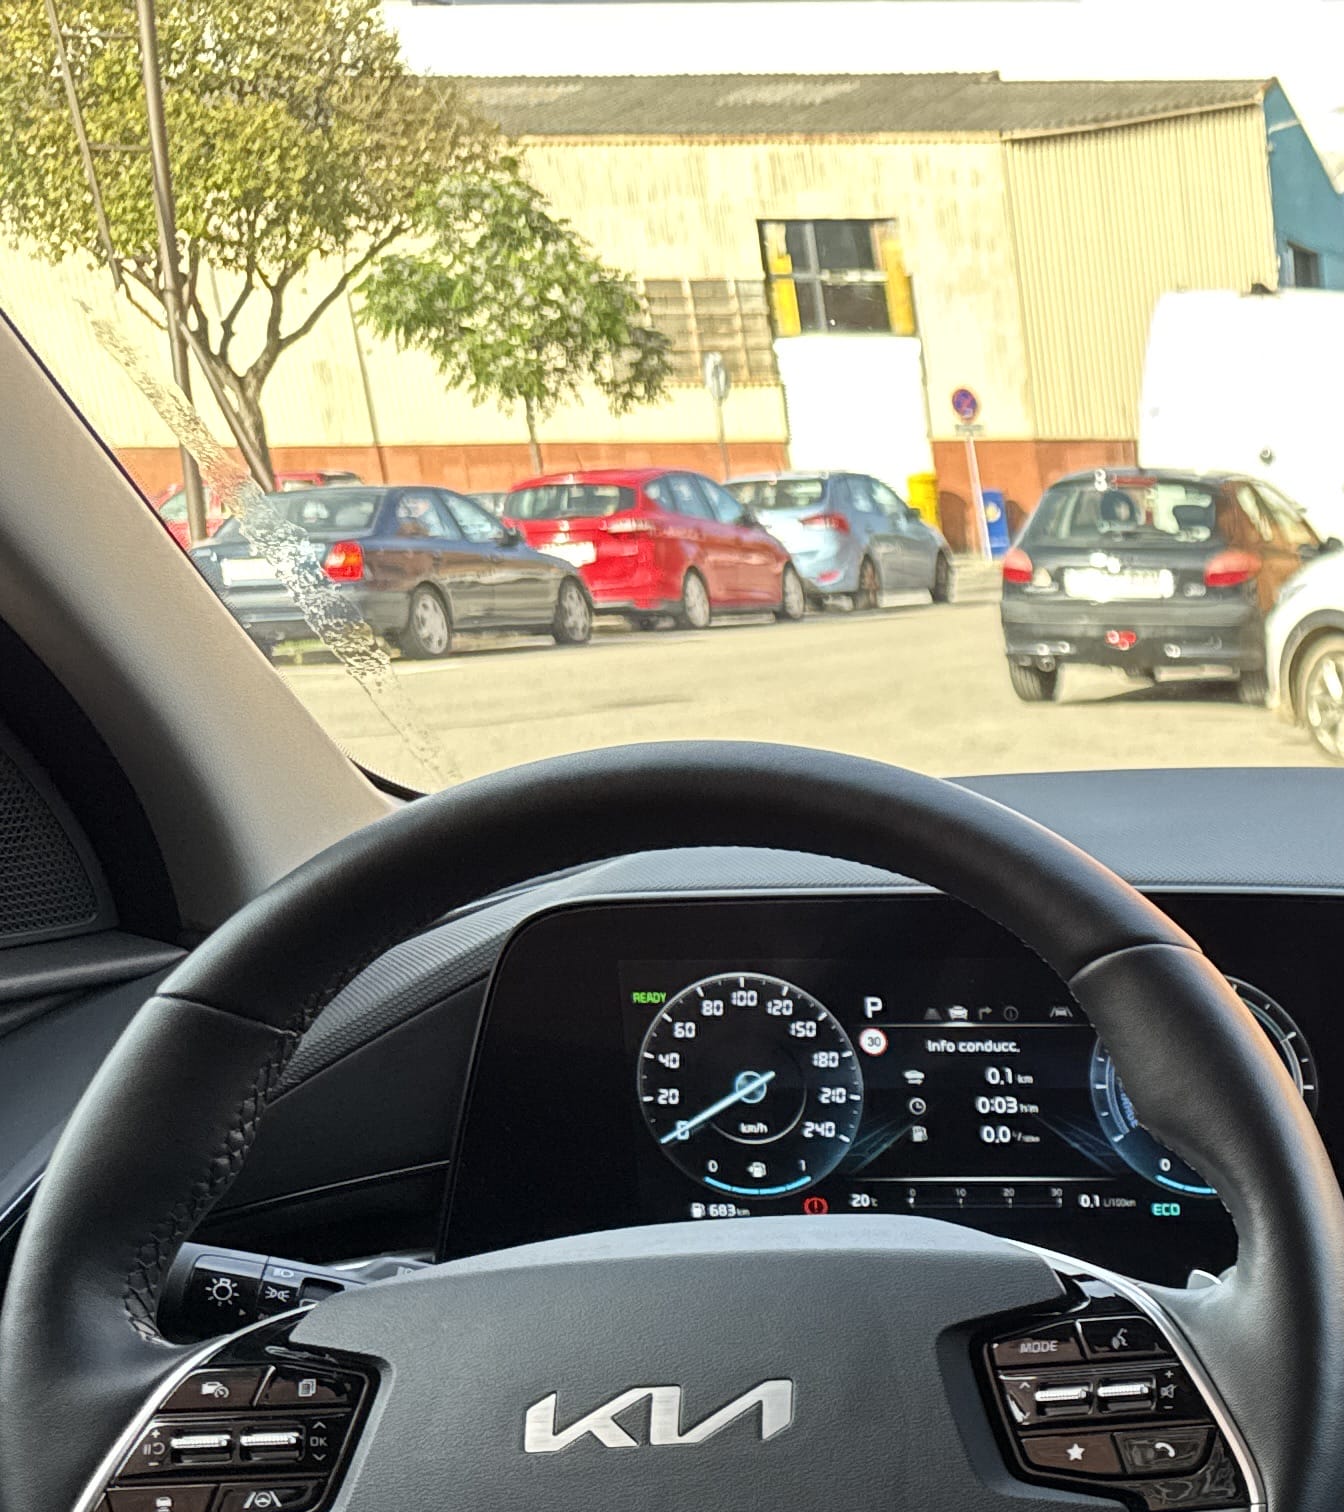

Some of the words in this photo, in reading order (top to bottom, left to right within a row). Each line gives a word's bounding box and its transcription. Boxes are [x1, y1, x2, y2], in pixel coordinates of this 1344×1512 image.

[632, 992, 667, 1004] READY
[731, 990, 758, 1007] 100
[701, 1000, 724, 1016] 80
[766, 1000, 793, 1016] 120
[864, 996, 883, 1018] P
[673, 1022, 696, 1038] 60
[789, 1021, 817, 1038] 150
[867, 1036, 882, 1047] 30
[927, 1040, 955, 1052] Info
[958, 1040, 1021, 1053] conducc.
[658, 1052, 680, 1069] 40
[812, 1051, 839, 1068] 180
[985, 1067, 1013, 1085] 0.1
[1017, 1074, 1034, 1085] km
[657, 1088, 680, 1105] 20
[819, 1087, 847, 1104] 210
[976, 1096, 1018, 1114] 0:03
[740, 1122, 768, 1134] km/h
[803, 1121, 836, 1138] 240
[981, 1126, 1012, 1143] 0.0
[707, 1160, 718, 1172] 0
[799, 1159, 806, 1172] 1
[1159, 1158, 1171, 1172] 0
[955, 1188, 967, 1197] 10
[1003, 1188, 1015, 1197] 20
[1051, 1188, 1063, 1197] 30
[1078, 1194, 1101, 1208] 0.1
[709, 1204, 737, 1217] 683
[1152, 1203, 1181, 1216] ECO
[1019, 1340, 1058, 1354] MODE
[309, 1436, 328, 1447] OK
